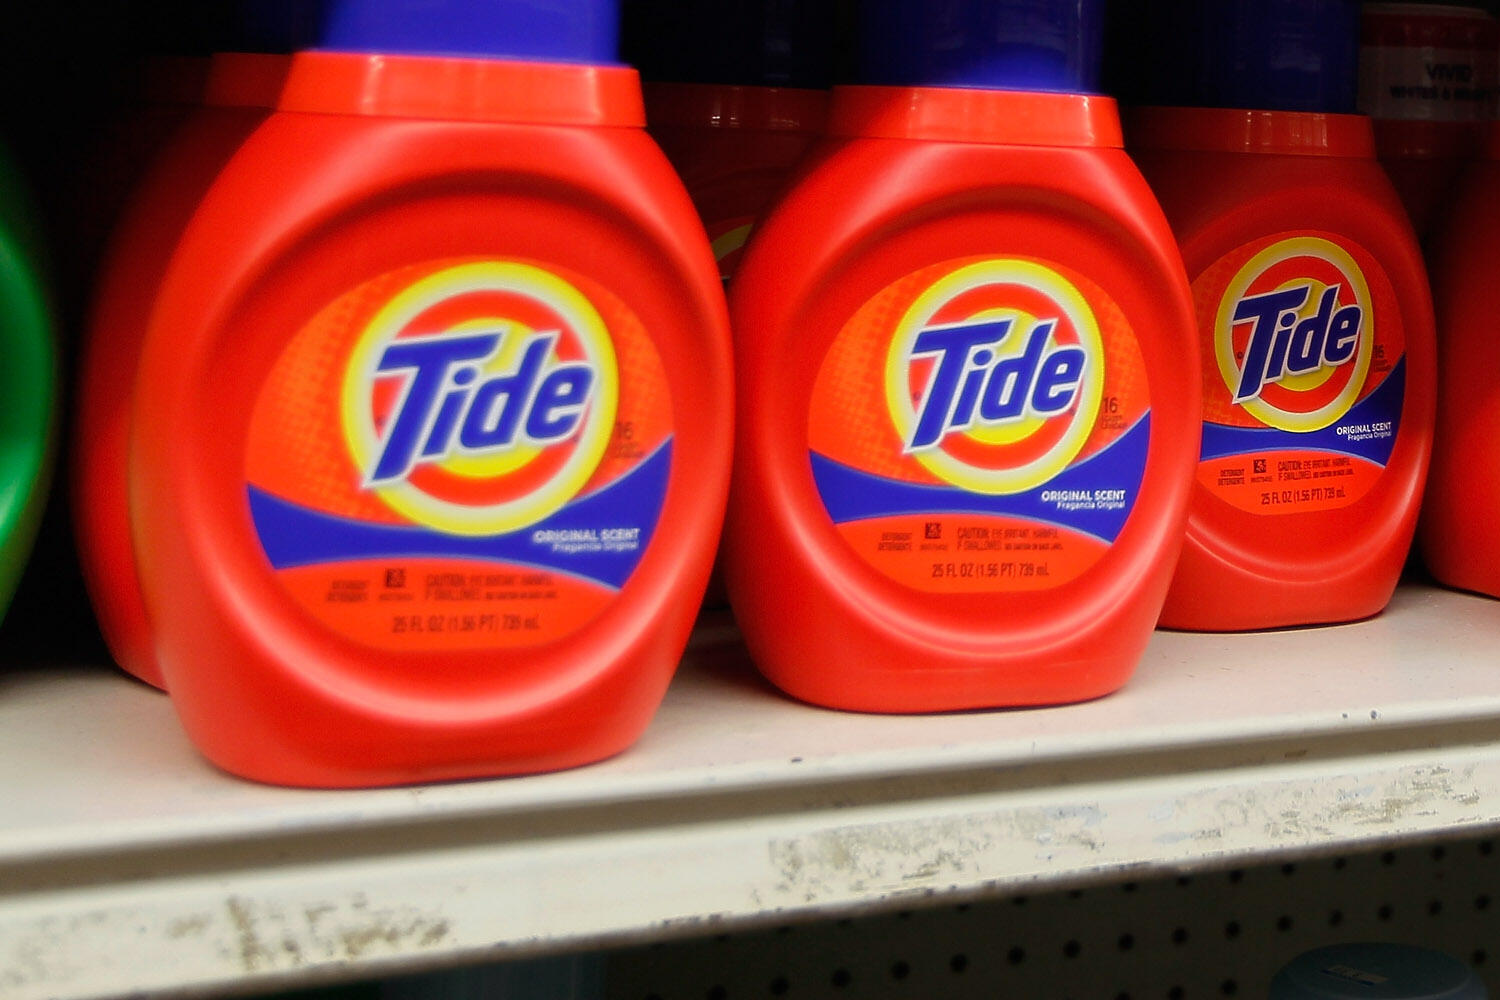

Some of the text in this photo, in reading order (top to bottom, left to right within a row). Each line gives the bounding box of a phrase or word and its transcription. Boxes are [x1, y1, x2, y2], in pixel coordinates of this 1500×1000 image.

[1231, 282, 1363, 404] Tide
[902, 316, 1088, 456] Tide
[364, 330, 596, 490] Tide
[1336, 421, 1392, 437] ORIGINAL SCENT
[1347, 432, 1374, 442] Fragancia
[1041, 489, 1126, 502] ORIGINAL SCENT
[1056, 500, 1126, 512] Fragancia Original
[534, 527, 641, 543] ORIGINAL SCENT
[960, 563, 974, 578] OZ
